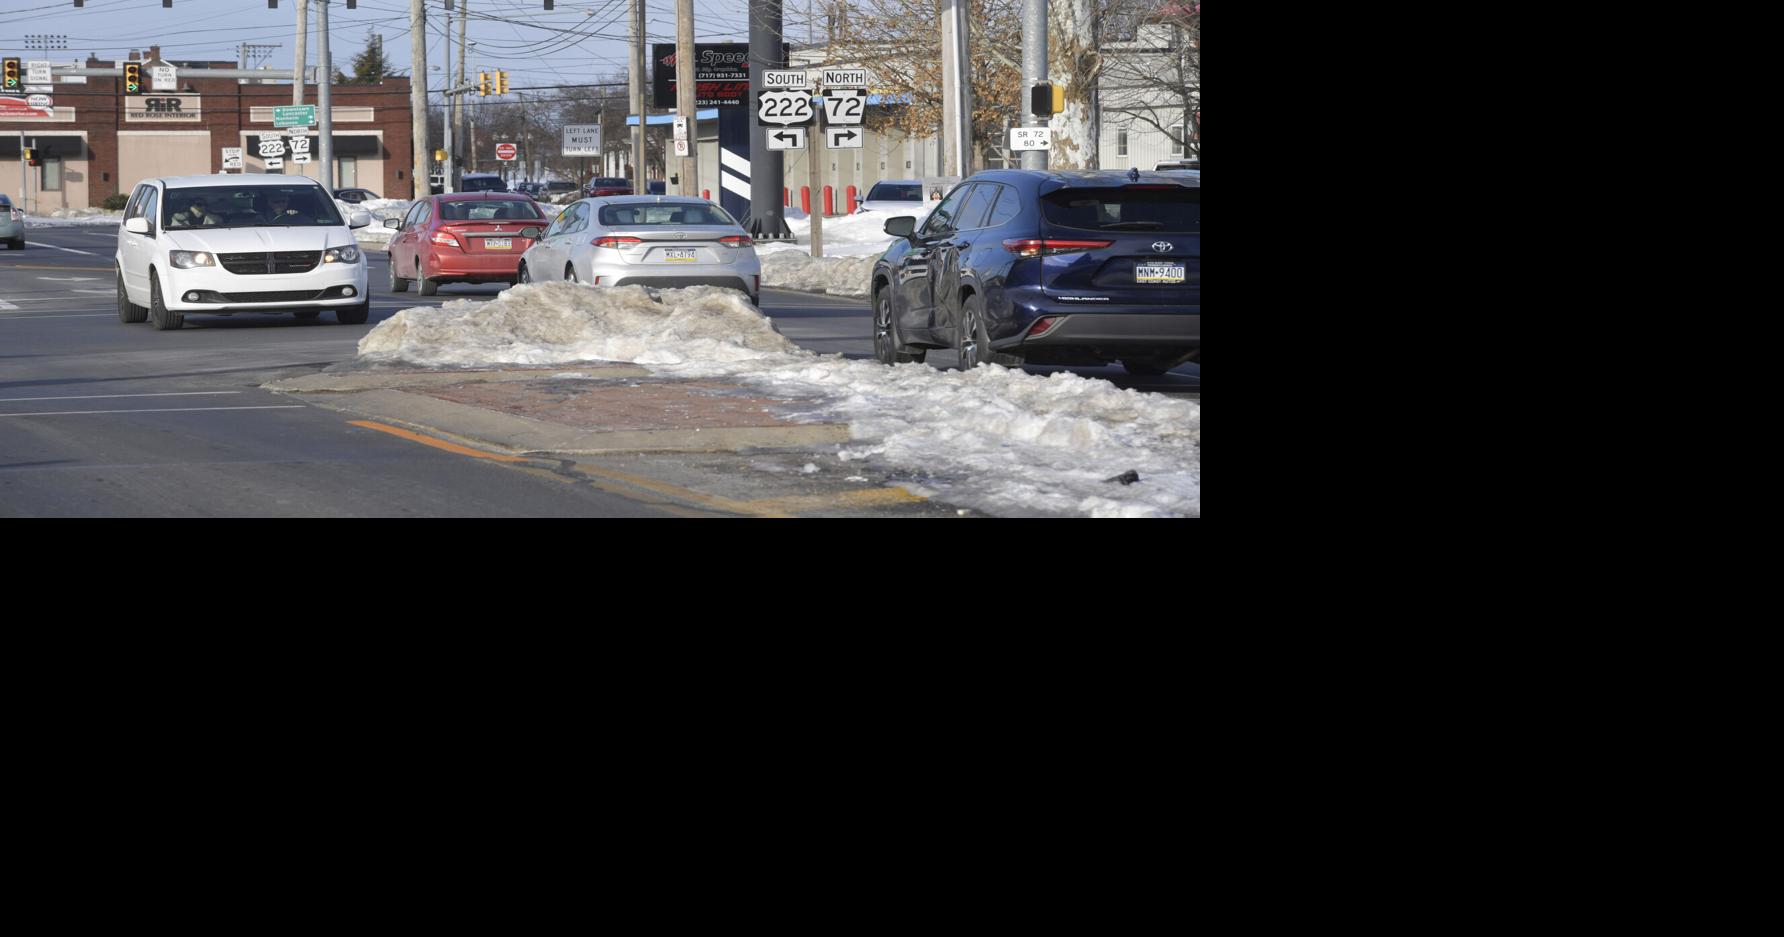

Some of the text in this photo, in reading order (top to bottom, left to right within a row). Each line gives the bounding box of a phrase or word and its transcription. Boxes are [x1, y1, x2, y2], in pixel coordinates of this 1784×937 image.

[767, 73, 804, 84] SOUTH
[826, 72, 863, 83] NORTH
[764, 98, 808, 117] 222
[827, 98, 861, 117] 72
[261, 143, 282, 154] 222
[291, 139, 308, 149] 72
